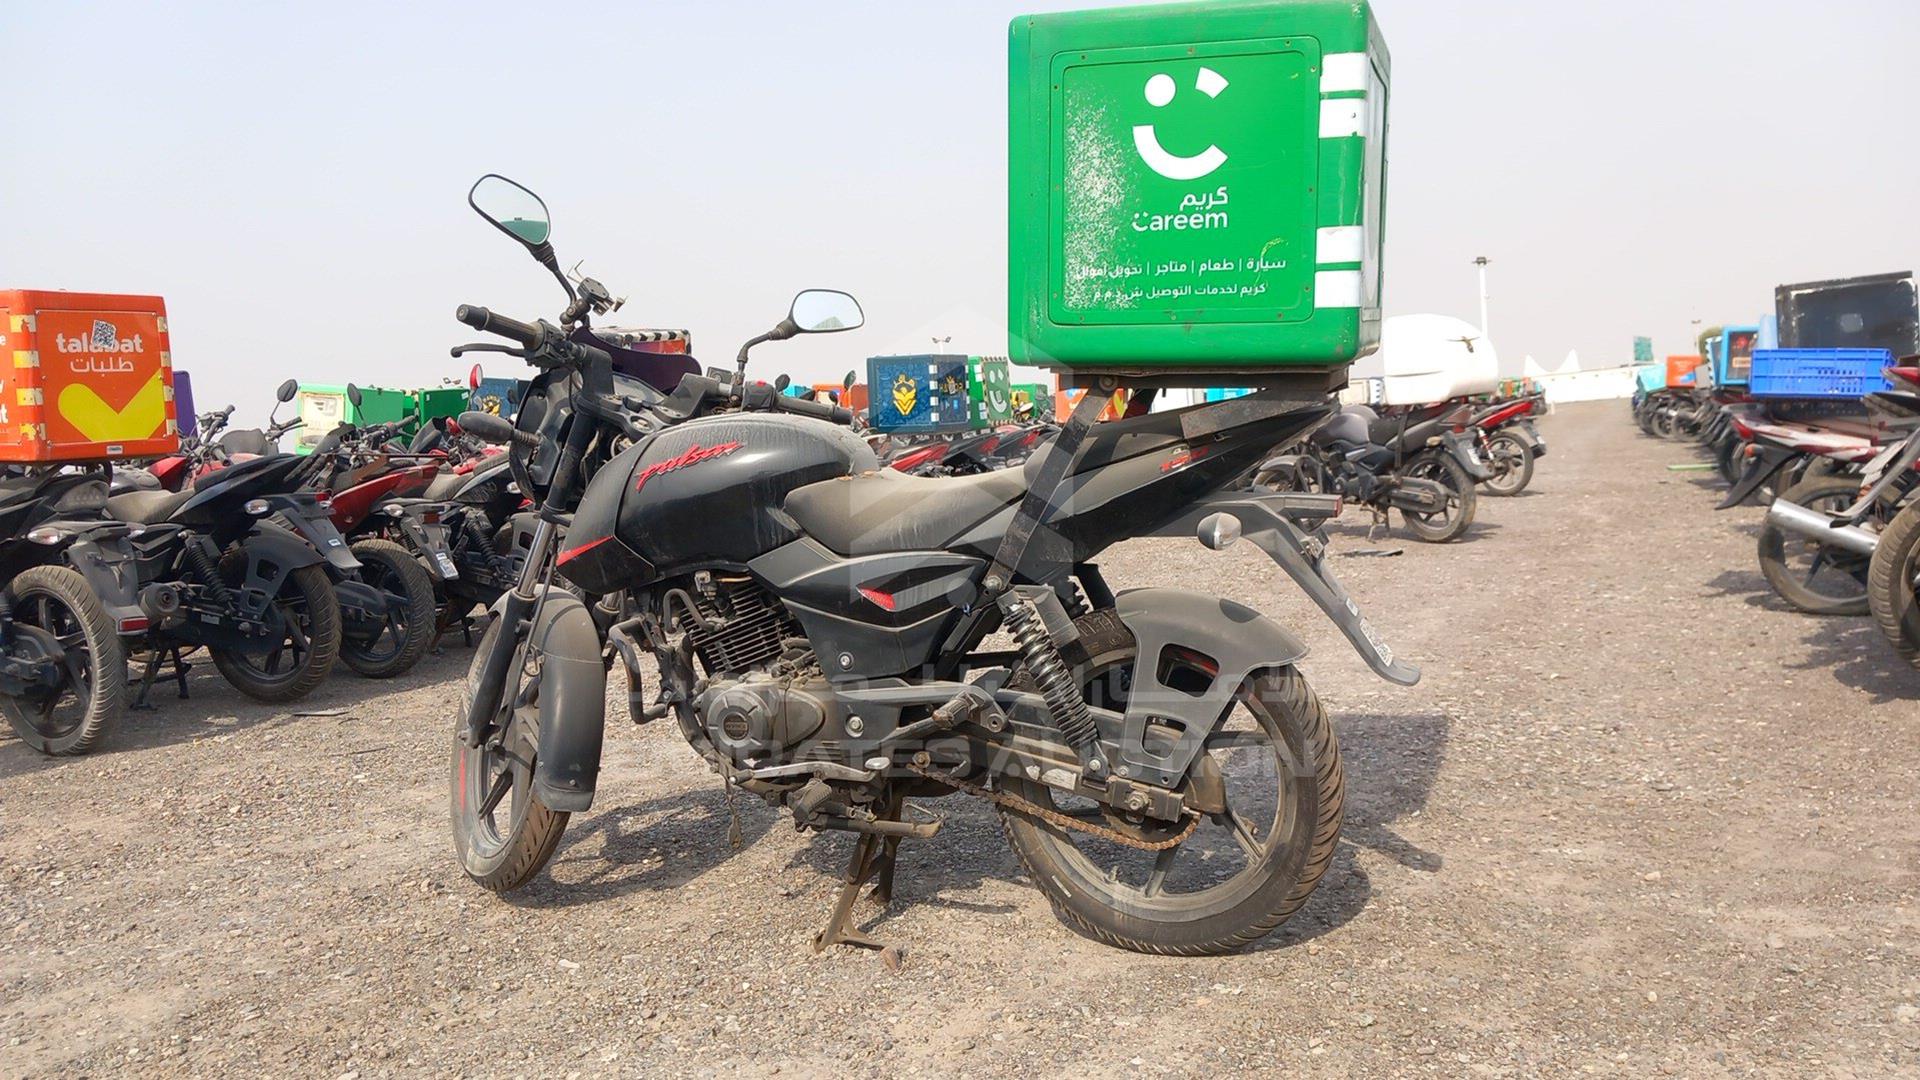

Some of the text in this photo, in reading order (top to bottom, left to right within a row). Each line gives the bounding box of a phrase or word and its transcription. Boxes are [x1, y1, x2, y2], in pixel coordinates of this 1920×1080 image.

[1179, 186, 1229, 211] كريم
[1131, 211, 1229, 232] Careem
[1154, 260, 1187, 276] متاجر
[1198, 259, 1234, 276] طعام
[1246, 257, 1287, 273] سيارة
[1146, 286, 1192, 300] التوصيل
[1194, 284, 1238, 297] لخدمات
[1239, 283, 1267, 298] كريم
[70, 356, 135, 377] طلبات
